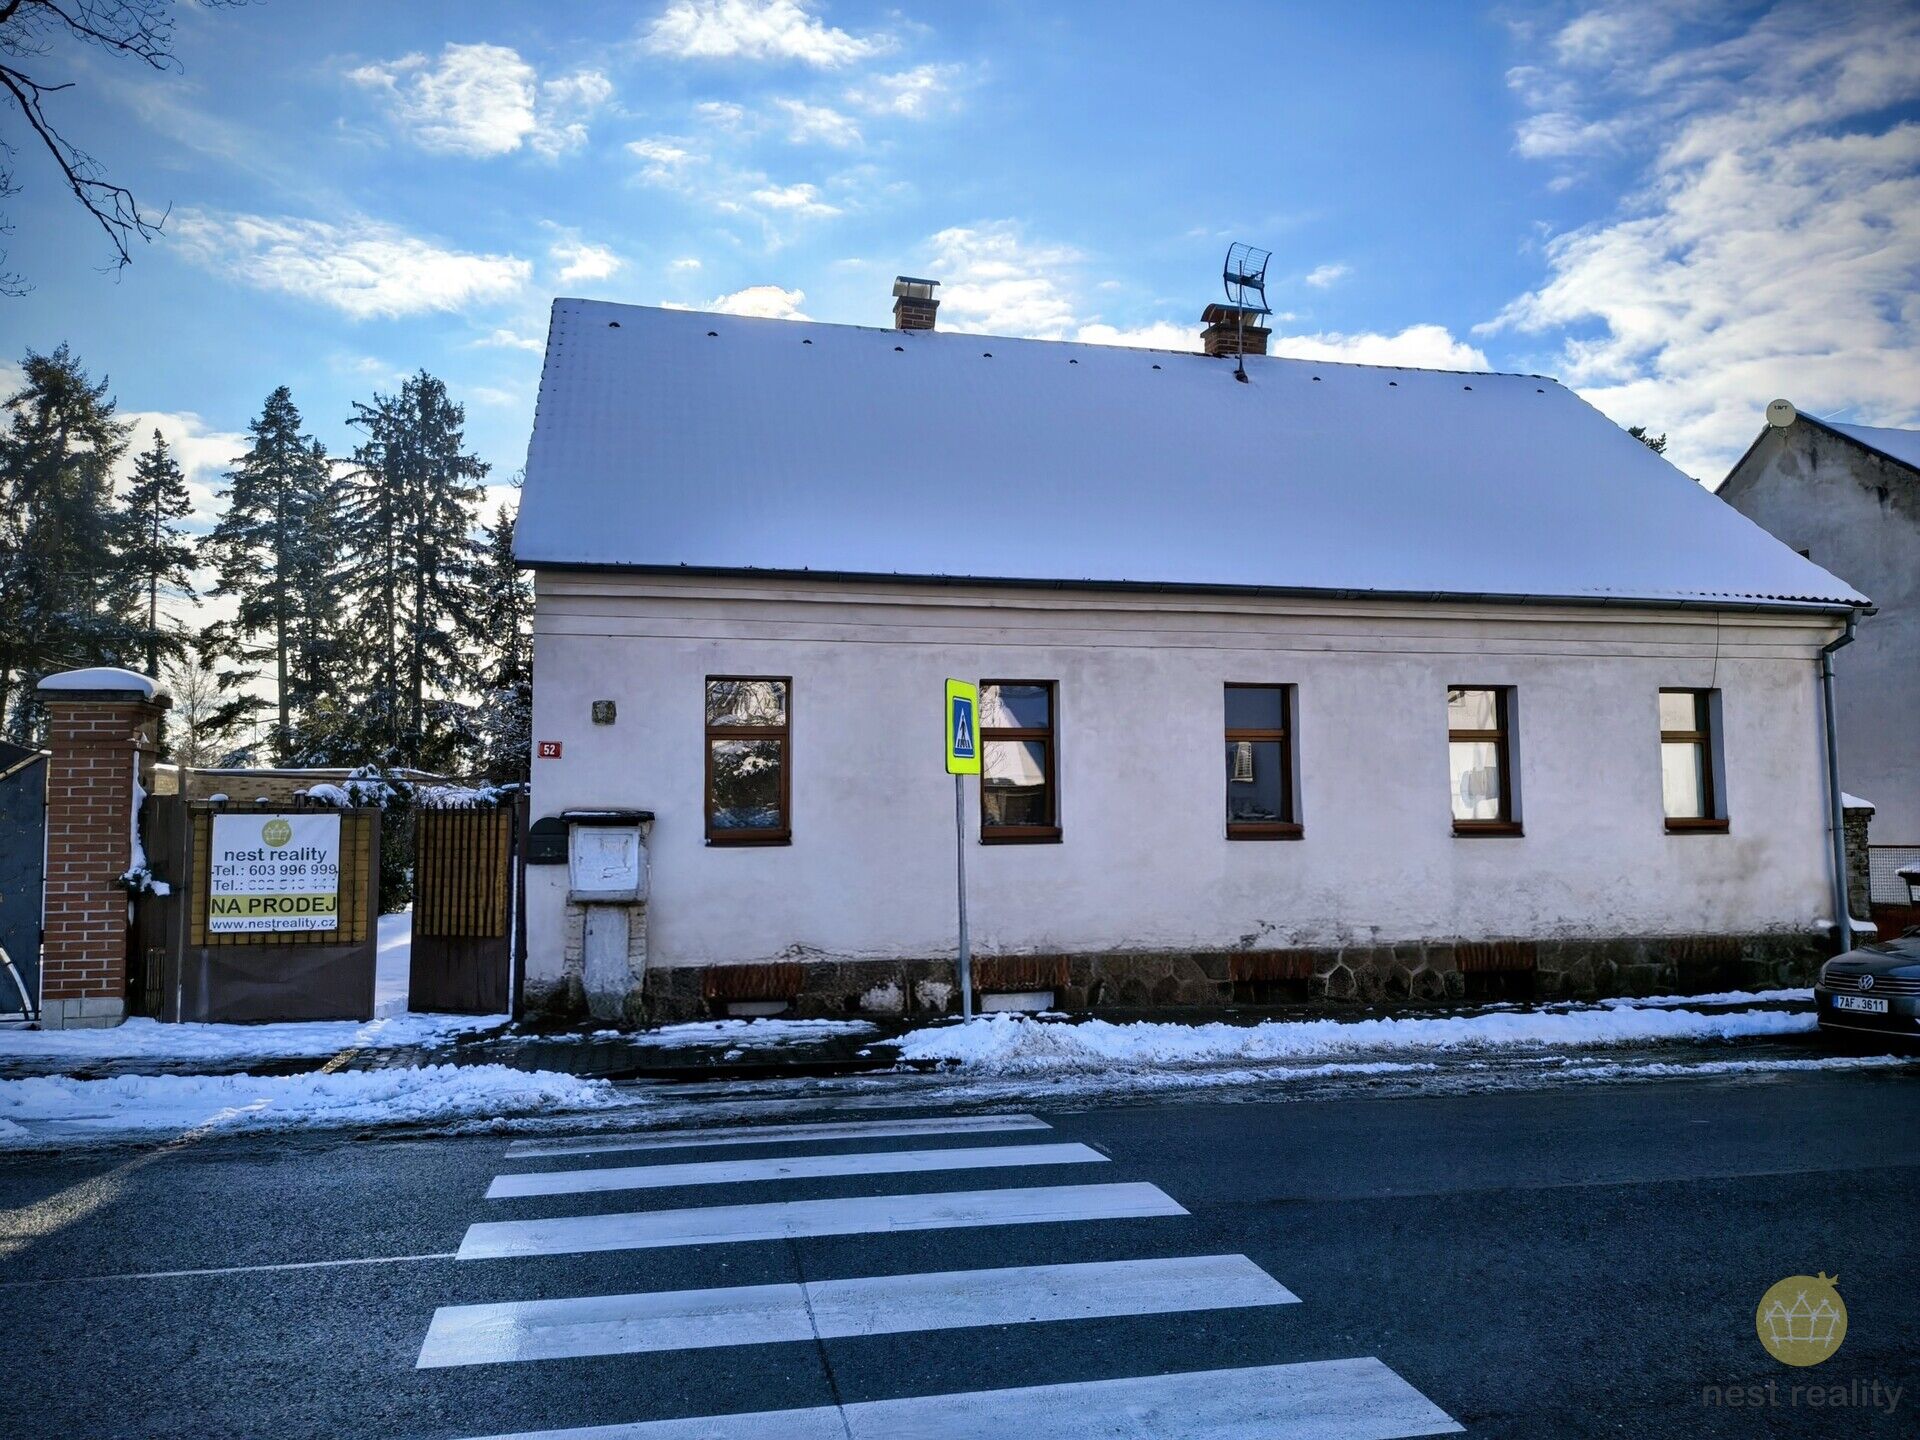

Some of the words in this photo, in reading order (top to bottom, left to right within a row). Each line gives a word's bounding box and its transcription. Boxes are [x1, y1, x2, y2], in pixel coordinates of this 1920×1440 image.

[543, 744, 556, 756] 52
[224, 848, 265, 862] nest
[270, 847, 327, 864] reality
[214, 865, 244, 876] Tel.:
[249, 864, 276, 876] 603
[280, 864, 306, 876] 996
[311, 864, 336, 875] 999
[213, 879, 244, 891] Tel.:
[211, 898, 242, 914] NA
[248, 897, 337, 914] PRODEJ
[211, 917, 336, 929] www.nestreality.cz
[1839, 996, 1855, 1008] 7AF
[1862, 999, 1884, 1011] 3611
